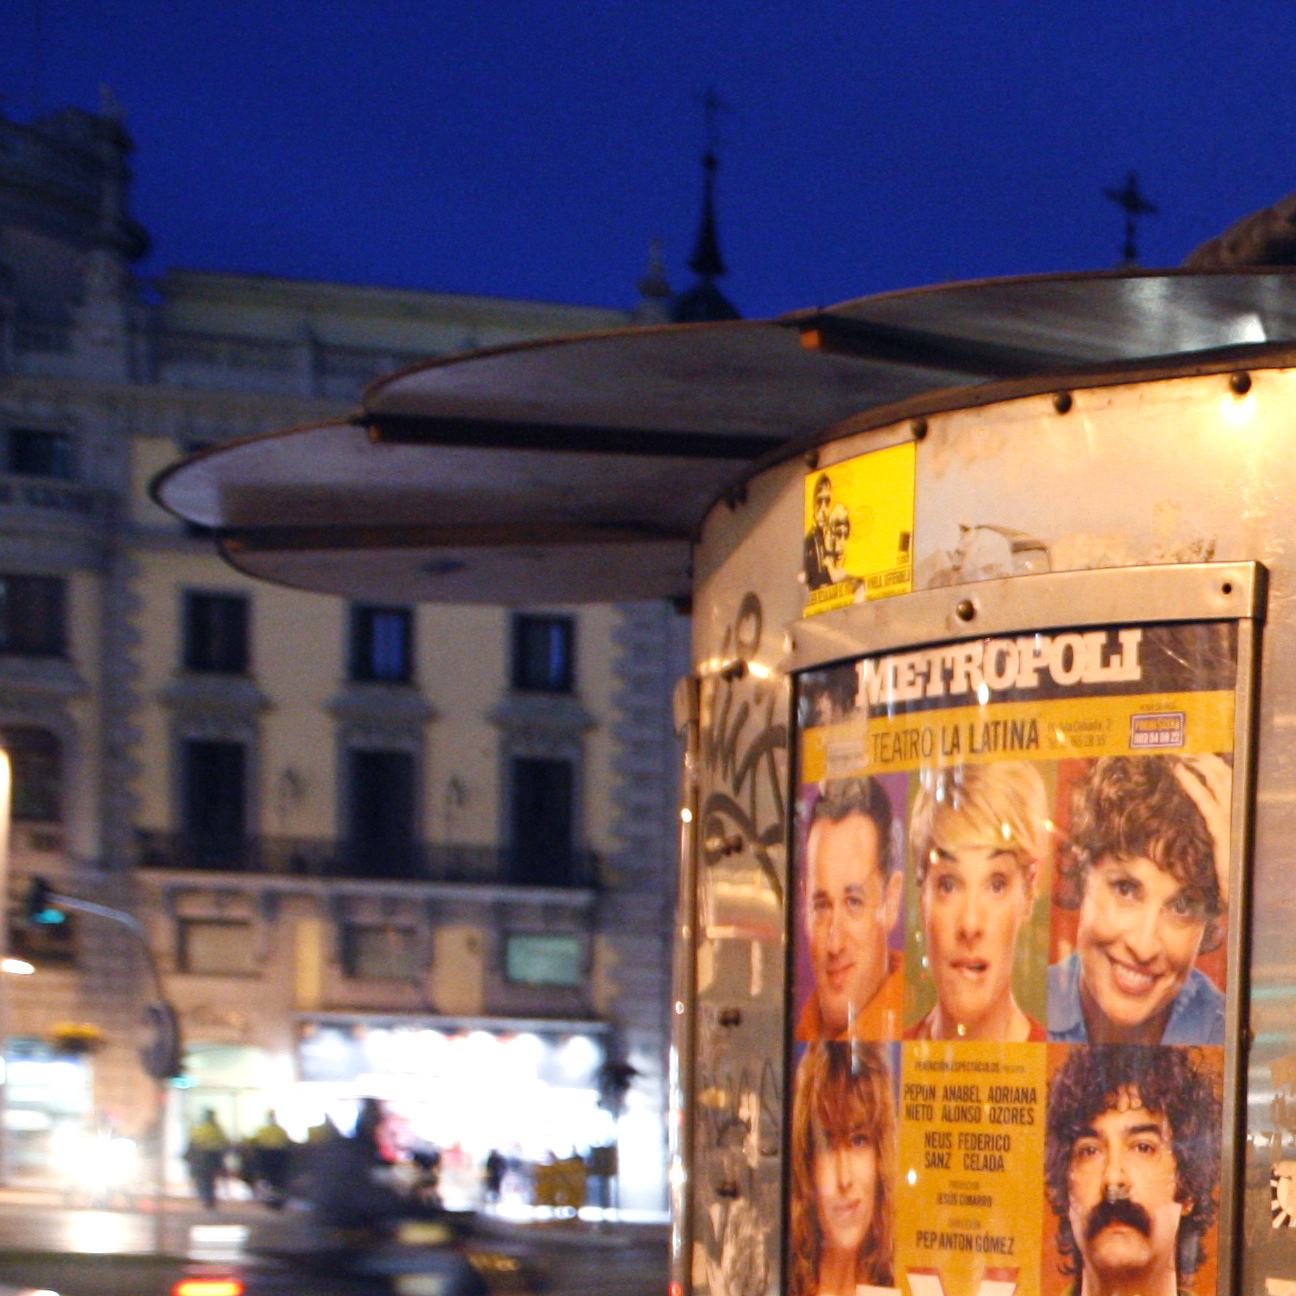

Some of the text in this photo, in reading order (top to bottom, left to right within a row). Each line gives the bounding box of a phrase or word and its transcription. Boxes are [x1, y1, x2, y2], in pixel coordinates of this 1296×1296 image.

[855, 629, 1141, 707] METROPOLI
[871, 718, 1040, 764] TEATRO LA LATINA
[942, 1085, 1037, 1104] ANABEL ADRIANA
[905, 1104, 1035, 1125] NIETO ALONSO OZORES
[924, 1131, 1011, 1151] NEUS FEDERICO
[924, 1151, 1005, 1171] SANZ CELADA
[975, 1233, 1015, 1255] GÓMEZ
